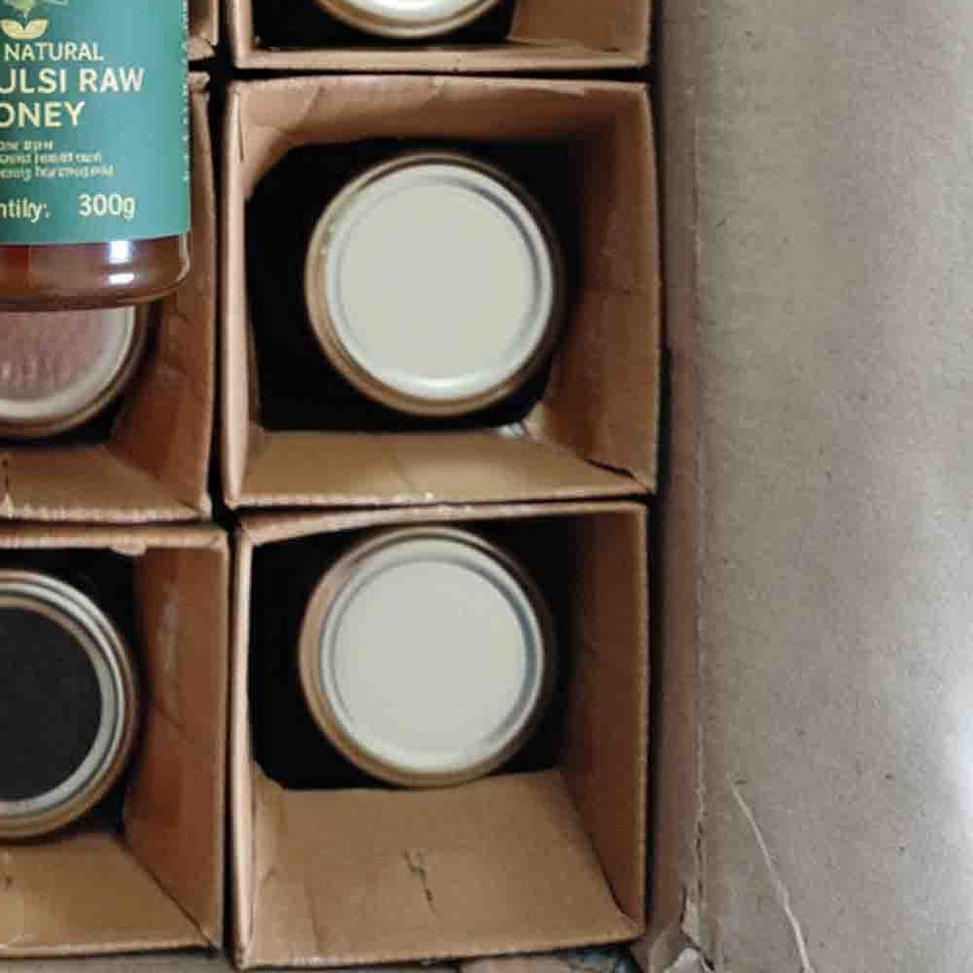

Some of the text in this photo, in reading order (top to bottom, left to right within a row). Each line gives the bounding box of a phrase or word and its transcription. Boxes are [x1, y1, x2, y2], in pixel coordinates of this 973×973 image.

[3, 41, 105, 61] NATURAL
[79, 67, 145, 93] RAW
[78, 193, 137, 219] 300g
